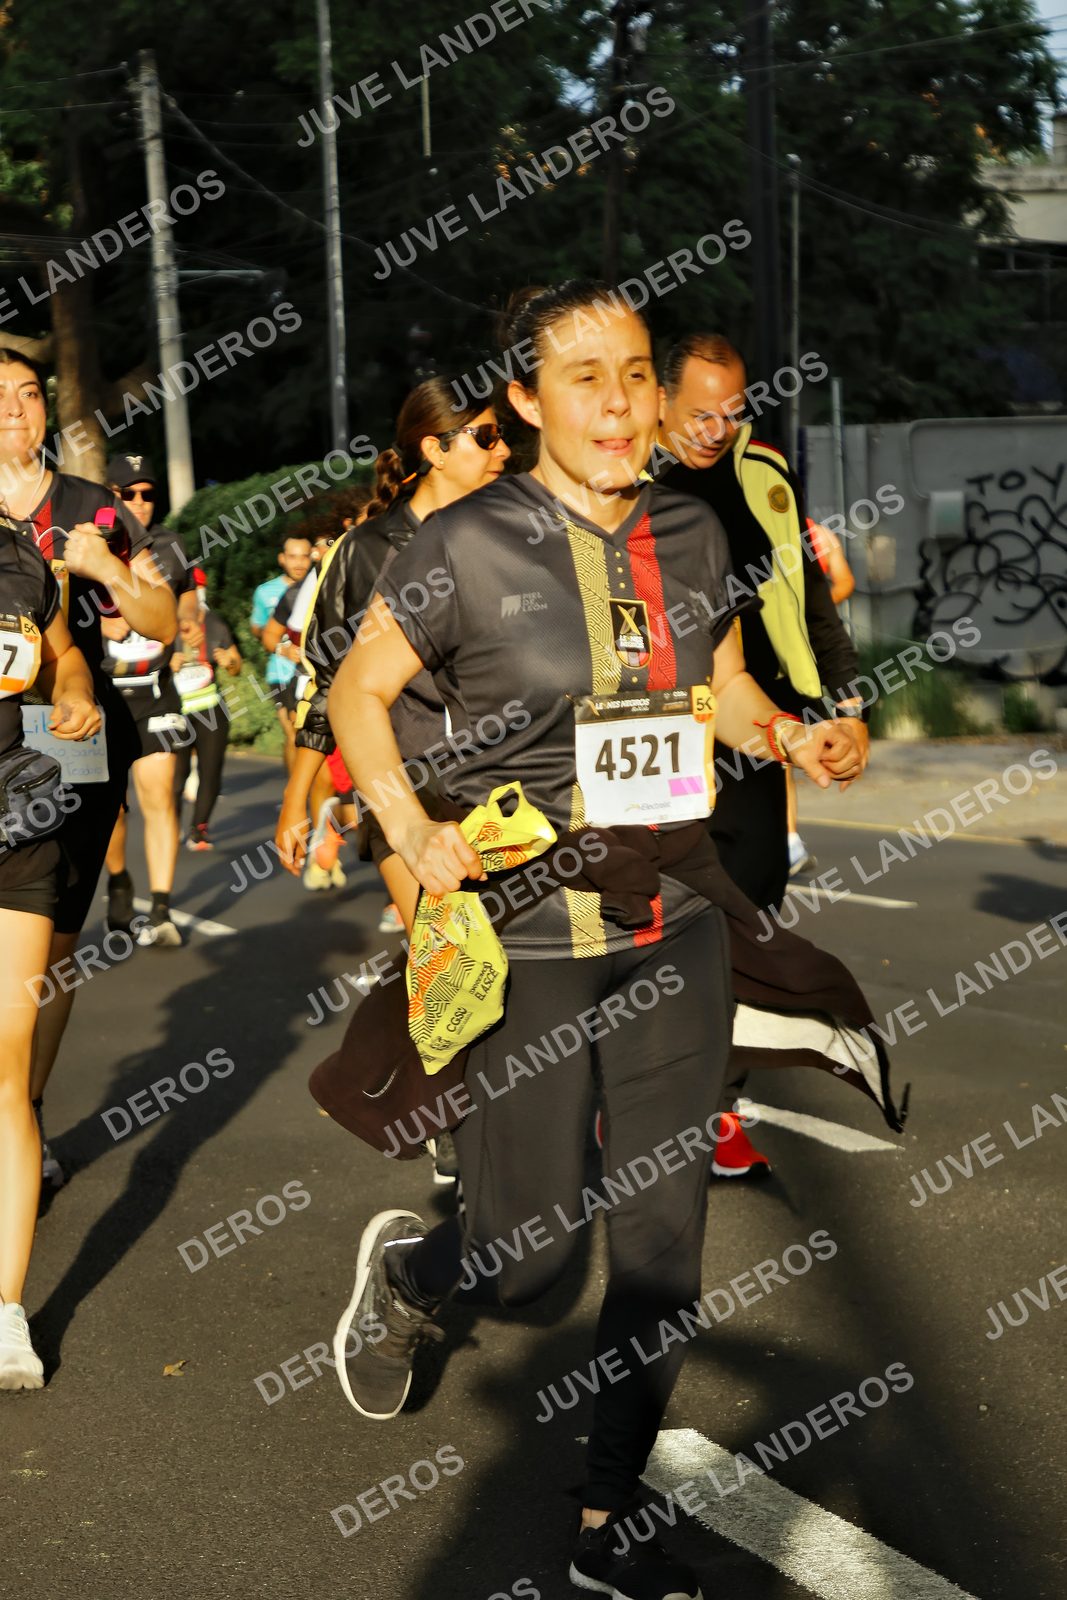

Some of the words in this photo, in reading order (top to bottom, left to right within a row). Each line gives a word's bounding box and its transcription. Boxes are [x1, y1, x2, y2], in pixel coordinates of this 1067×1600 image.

[24, 623, 37, 635] 5K
[3, 644, 18, 675] 7
[696, 697, 713, 712] 5K
[595, 732, 680, 780] 4521
